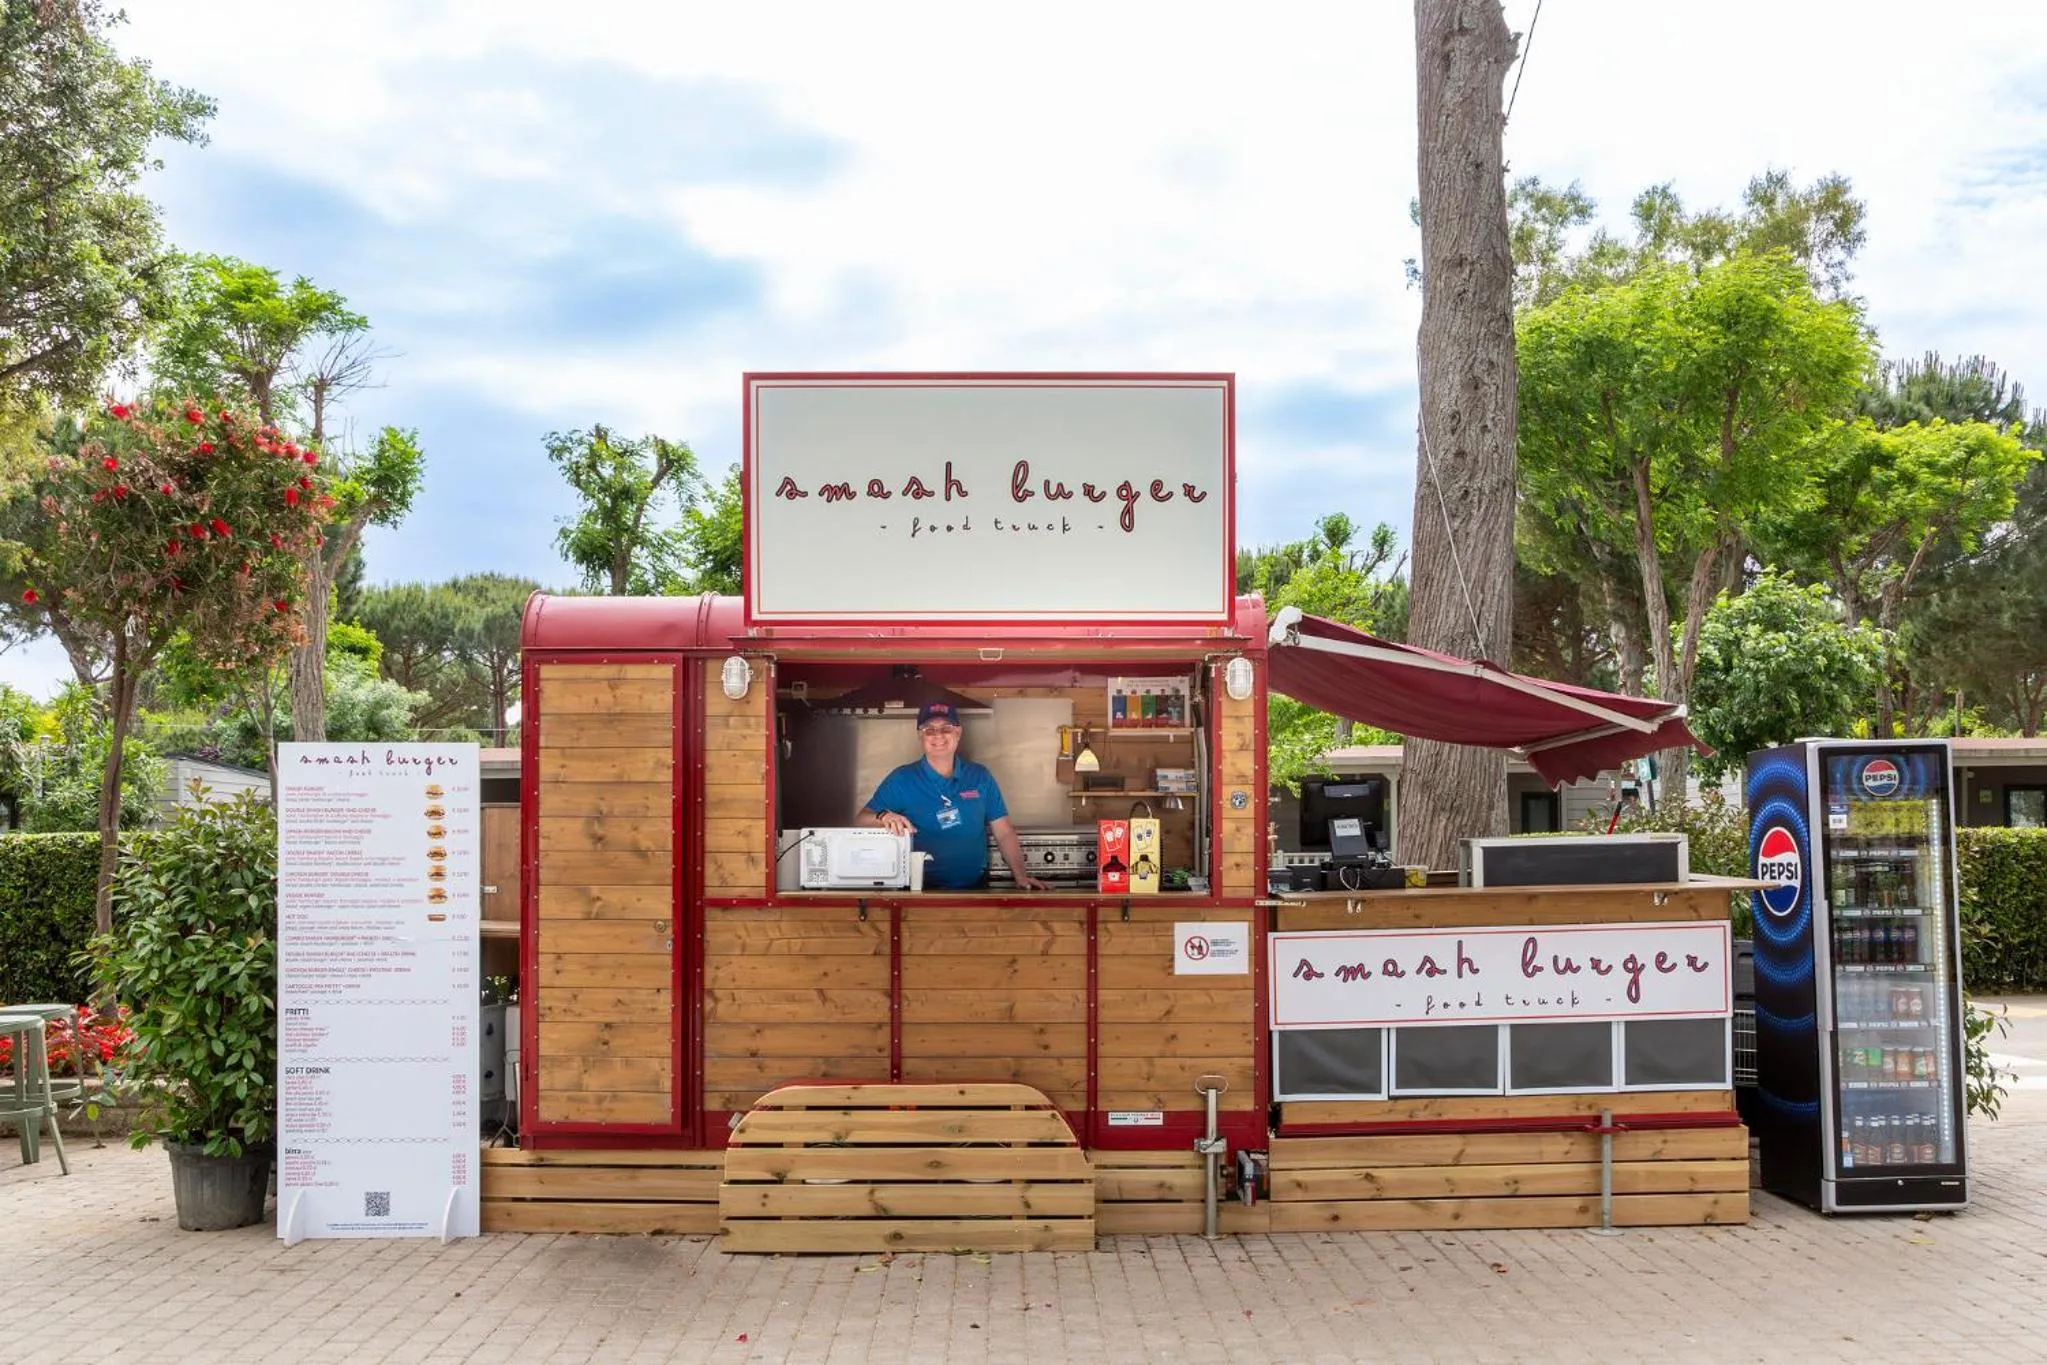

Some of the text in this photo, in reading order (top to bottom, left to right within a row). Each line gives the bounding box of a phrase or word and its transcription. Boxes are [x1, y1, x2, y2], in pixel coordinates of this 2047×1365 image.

[775, 460, 1208, 533] smash burger
[911, 516, 1072, 538] food truck
[300, 750, 459, 776] smash burger
[1865, 774, 1897, 784] PEPSI
[1761, 862, 1798, 881] PEPSI
[1293, 937, 1709, 1003] smash burger
[1425, 990, 1580, 1015] food truck
[285, 1067, 304, 1075] SOFT
